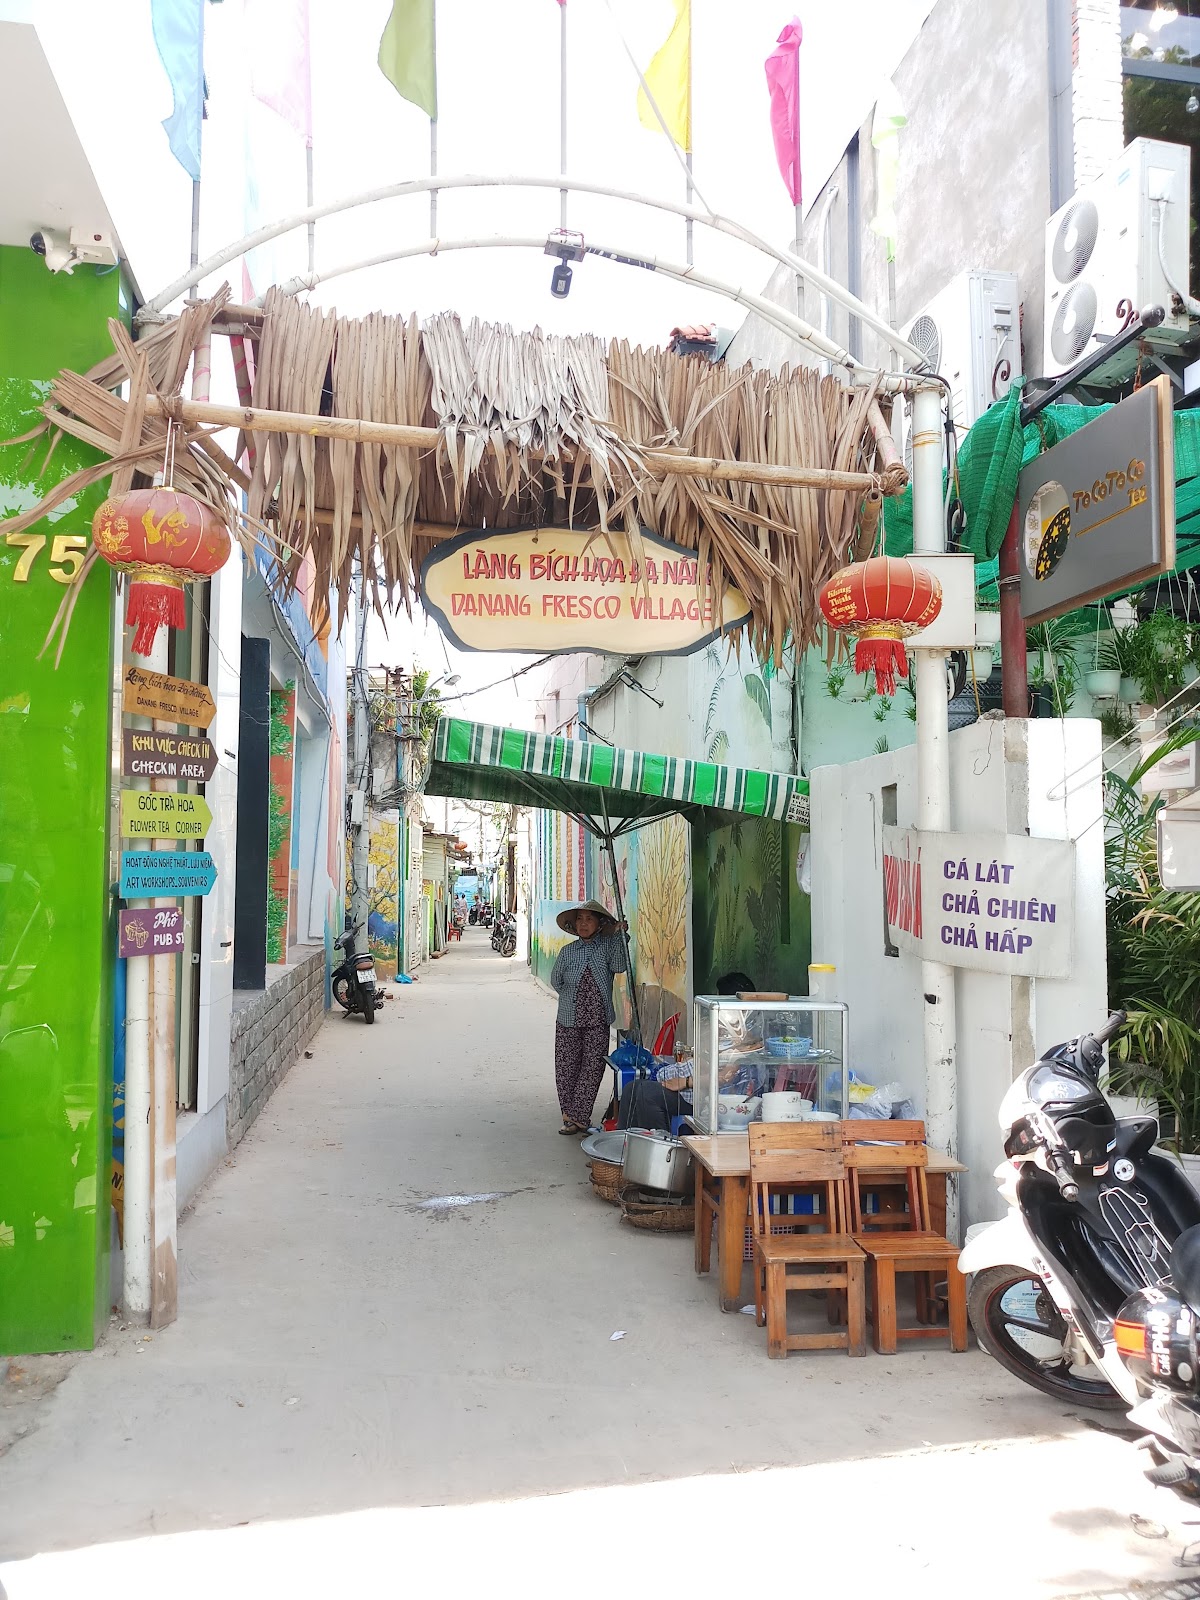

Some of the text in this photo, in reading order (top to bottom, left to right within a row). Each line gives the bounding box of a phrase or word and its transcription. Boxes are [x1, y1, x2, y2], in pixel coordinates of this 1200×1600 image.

[6, 532, 87, 583] 75
[463, 549, 520, 579] LÀNG
[530, 548, 580, 581] BÍCH
[581, 556, 626, 586] HỌA
[451, 593, 712, 620] DANANG FRESCO VILLAGE
[137, 696, 199, 717] DANANG FRESCO VILLAGE
[132, 734, 154, 752] KHU
[180, 763, 205, 778] AREA
[138, 793, 195, 812] GÓC TRÀ HOA
[130, 820, 202, 834] FLOWER TEA CORNER
[943, 857, 1014, 884] CÁ LÁT
[126, 877, 140, 889] ART
[942, 890, 1056, 923] CHẢ CHIÊN
[153, 933, 173, 946] PUB
[941, 923, 1033, 954] CHẢ HẤP
